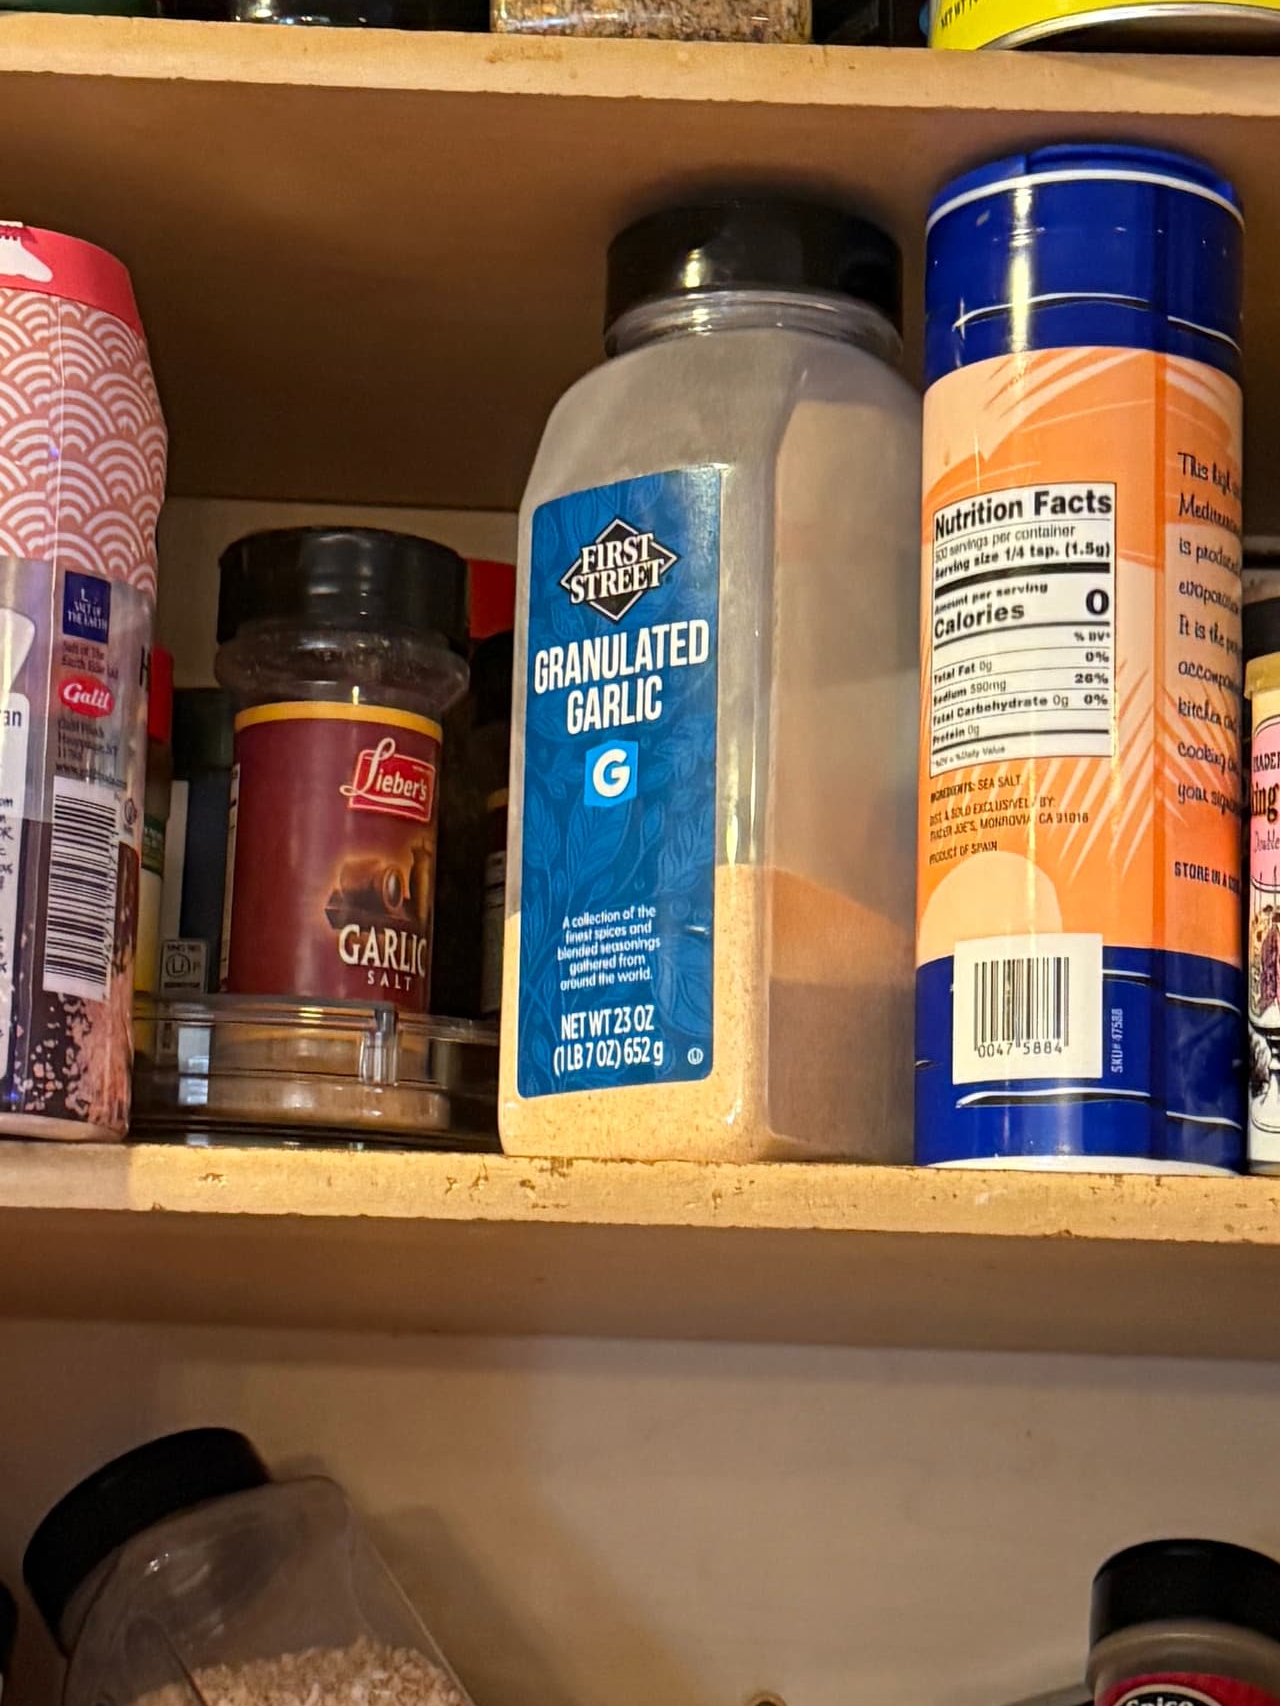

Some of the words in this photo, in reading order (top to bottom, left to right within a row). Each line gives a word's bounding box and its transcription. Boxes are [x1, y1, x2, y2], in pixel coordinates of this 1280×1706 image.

[935, 497, 1023, 541] Nutrition
[1034, 489, 1112, 516] Facts
[581, 533, 654, 574] FIRST
[570, 558, 664, 604] STREET
[934, 604, 1025, 639] Calories
[1085, 588, 1110, 616] 0
[534, 619, 709, 694] GRANULATED
[63, 683, 110, 710] Galil
[566, 675, 663, 735] GARLIC
[339, 737, 427, 810] Lieber's
[592, 748, 630, 798] G
[563, 916, 570, 930] A
[572, 909, 621, 928] collection
[623, 906, 635, 920] of
[638, 904, 657, 918] the
[565, 926, 592, 945] finest
[594, 924, 627, 942] spices
[629, 921, 652, 935] and
[339, 923, 427, 978] GARLIC
[557, 943, 598, 960] blended
[600, 937, 661, 955] seasonings
[569, 956, 617, 976] gathered
[619, 954, 646, 968] from
[367, 970, 411, 991] SALT
[560, 974, 596, 991] around
[598, 972, 615, 986] the
[617, 967, 653, 983] world.
[561, 1013, 586, 1041] NET
[588, 1008, 613, 1037] WT
[614, 1007, 631, 1034] 23
[634, 1005, 655, 1032] OZ
[554, 1045, 565, 1077] (1
[567, 1041, 584, 1071] LB
[585, 1041, 594, 1069] 7
[596, 1039, 622, 1070] OZ)
[624, 1037, 651, 1065] 652
[653, 1040, 664, 1067] g
[977, 1042, 1013, 1059] 0047
[1023, 1041, 1063, 1057] 5884
